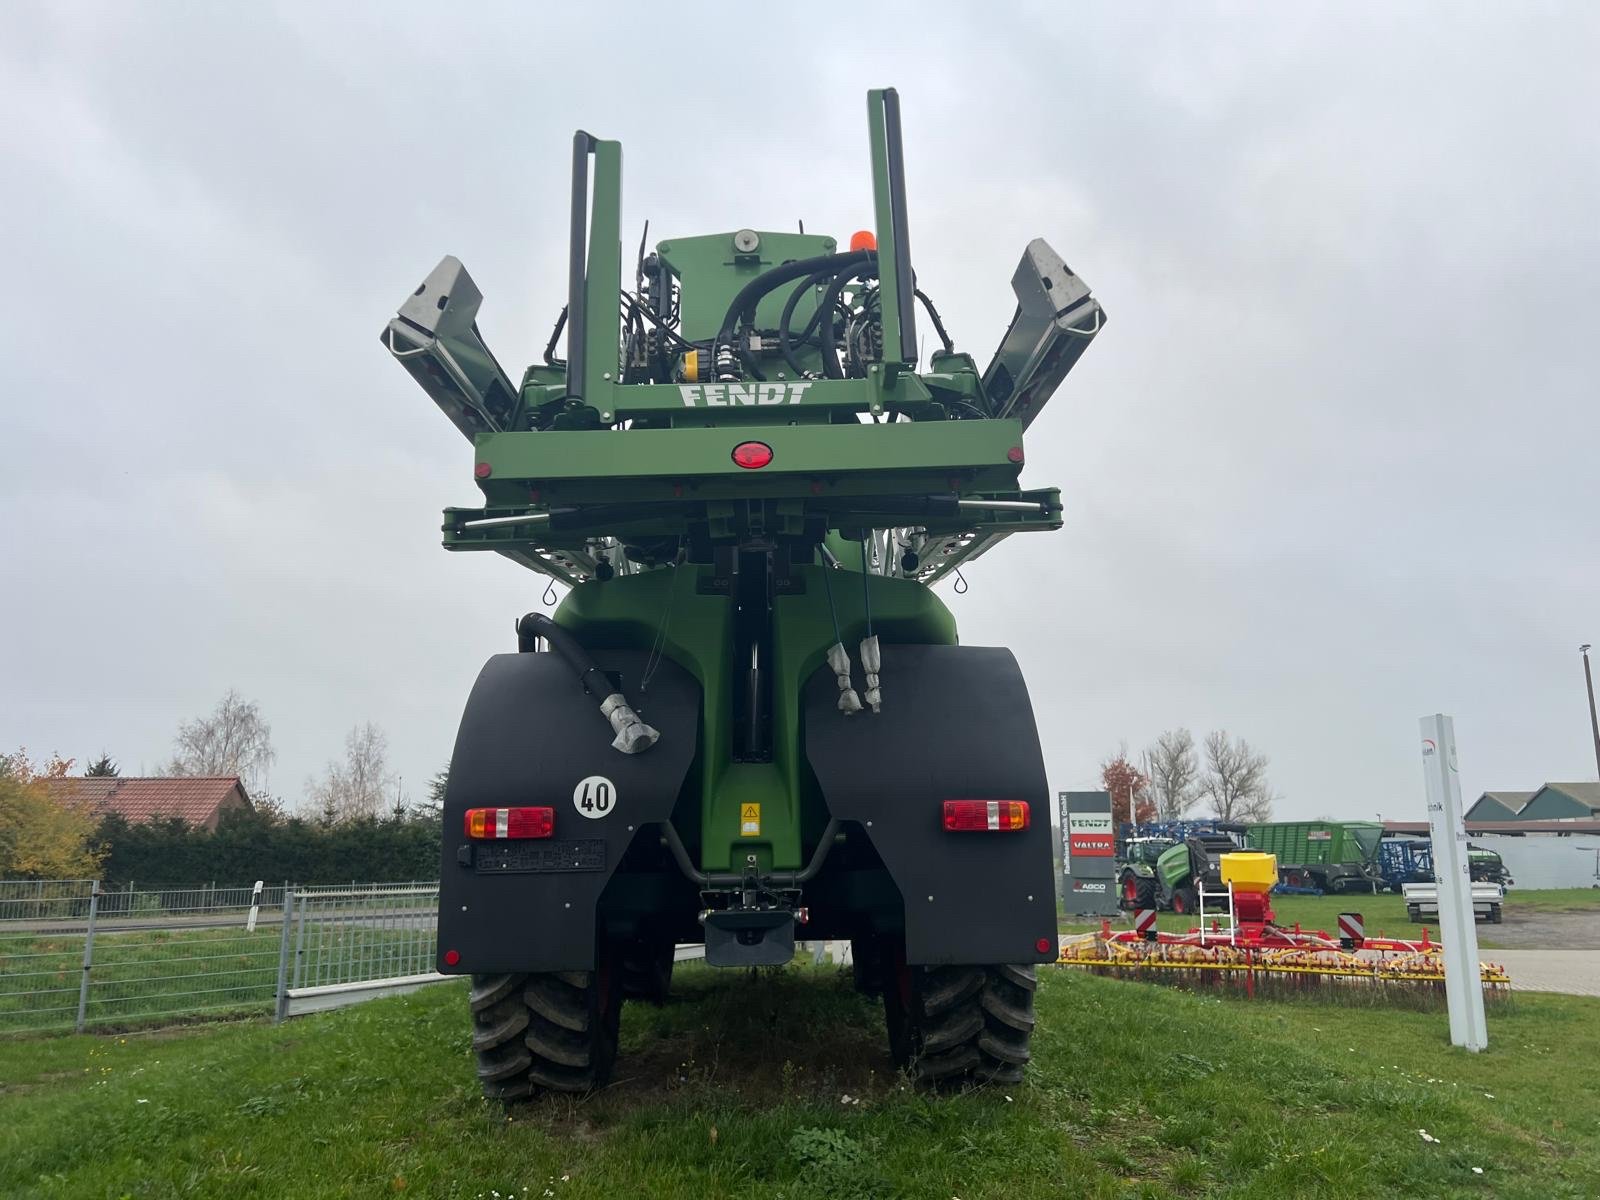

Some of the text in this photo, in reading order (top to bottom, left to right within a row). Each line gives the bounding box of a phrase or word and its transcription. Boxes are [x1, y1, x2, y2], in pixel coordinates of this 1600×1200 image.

[679, 382, 812, 407] FENDT
[581, 783, 609, 812] 40
[1070, 819, 1111, 828] FENDT
